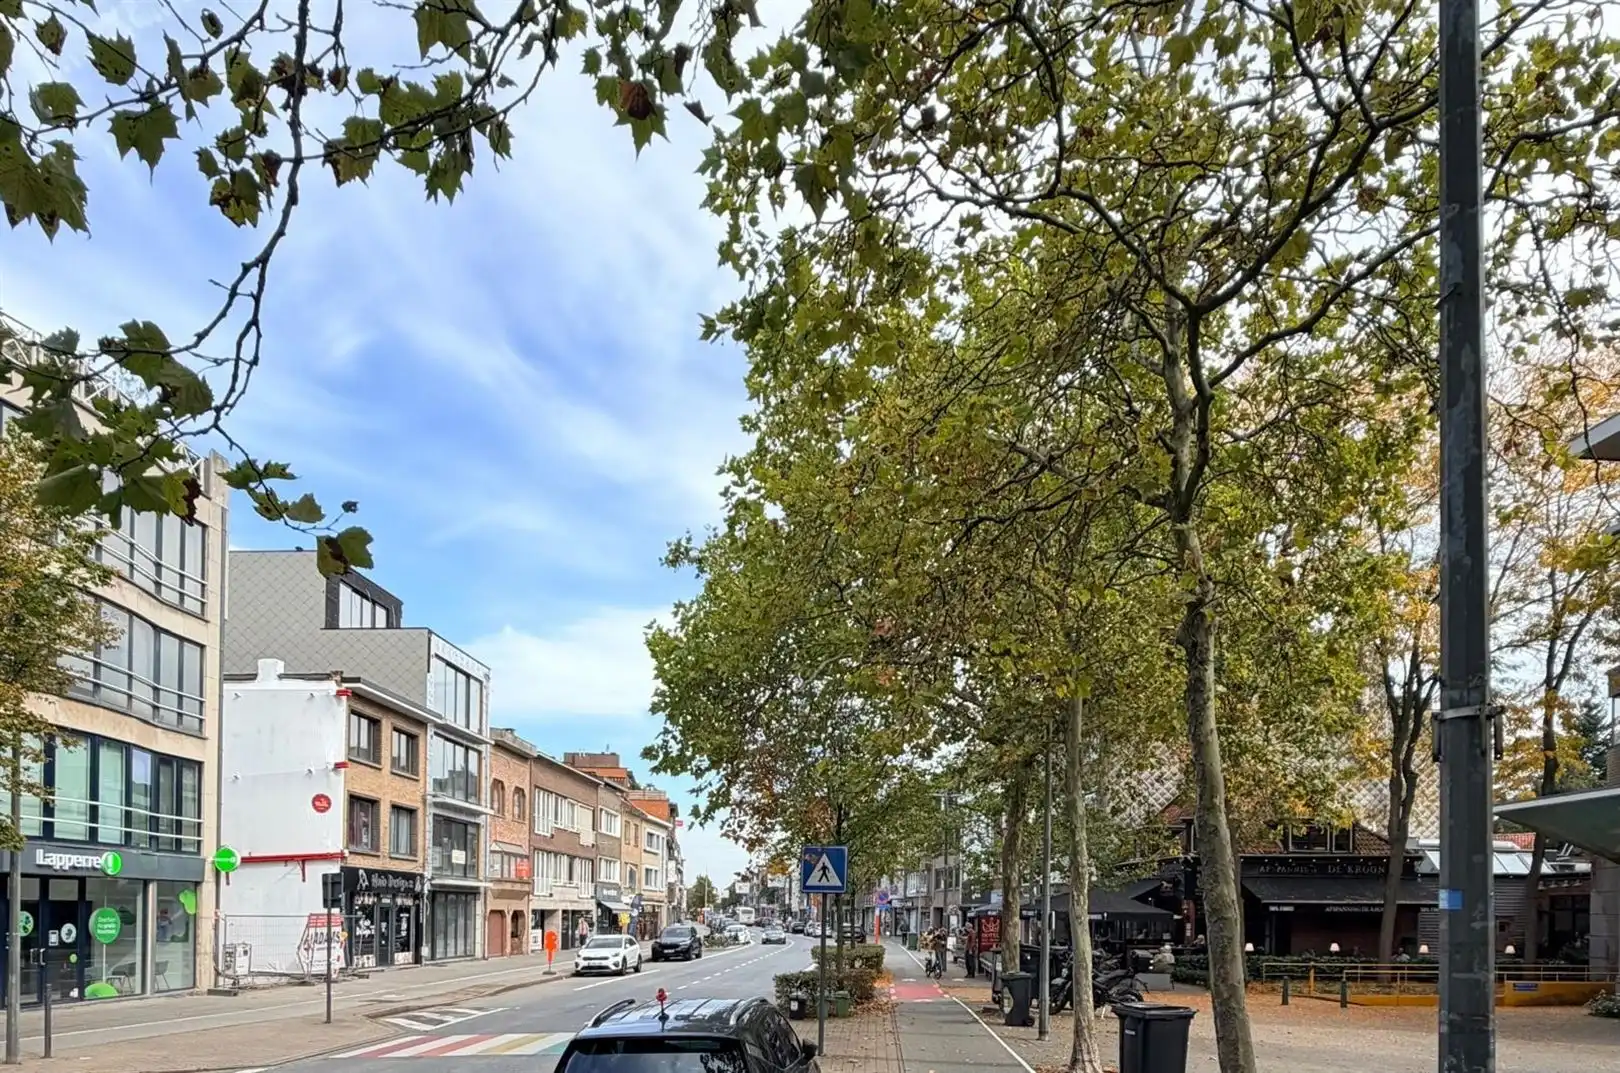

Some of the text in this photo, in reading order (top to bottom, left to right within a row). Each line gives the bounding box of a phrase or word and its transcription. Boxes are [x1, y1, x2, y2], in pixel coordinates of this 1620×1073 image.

[36, 848, 102, 870] Lapperre
[1328, 864, 1342, 874] DE
[1347, 864, 1386, 874] KROON
